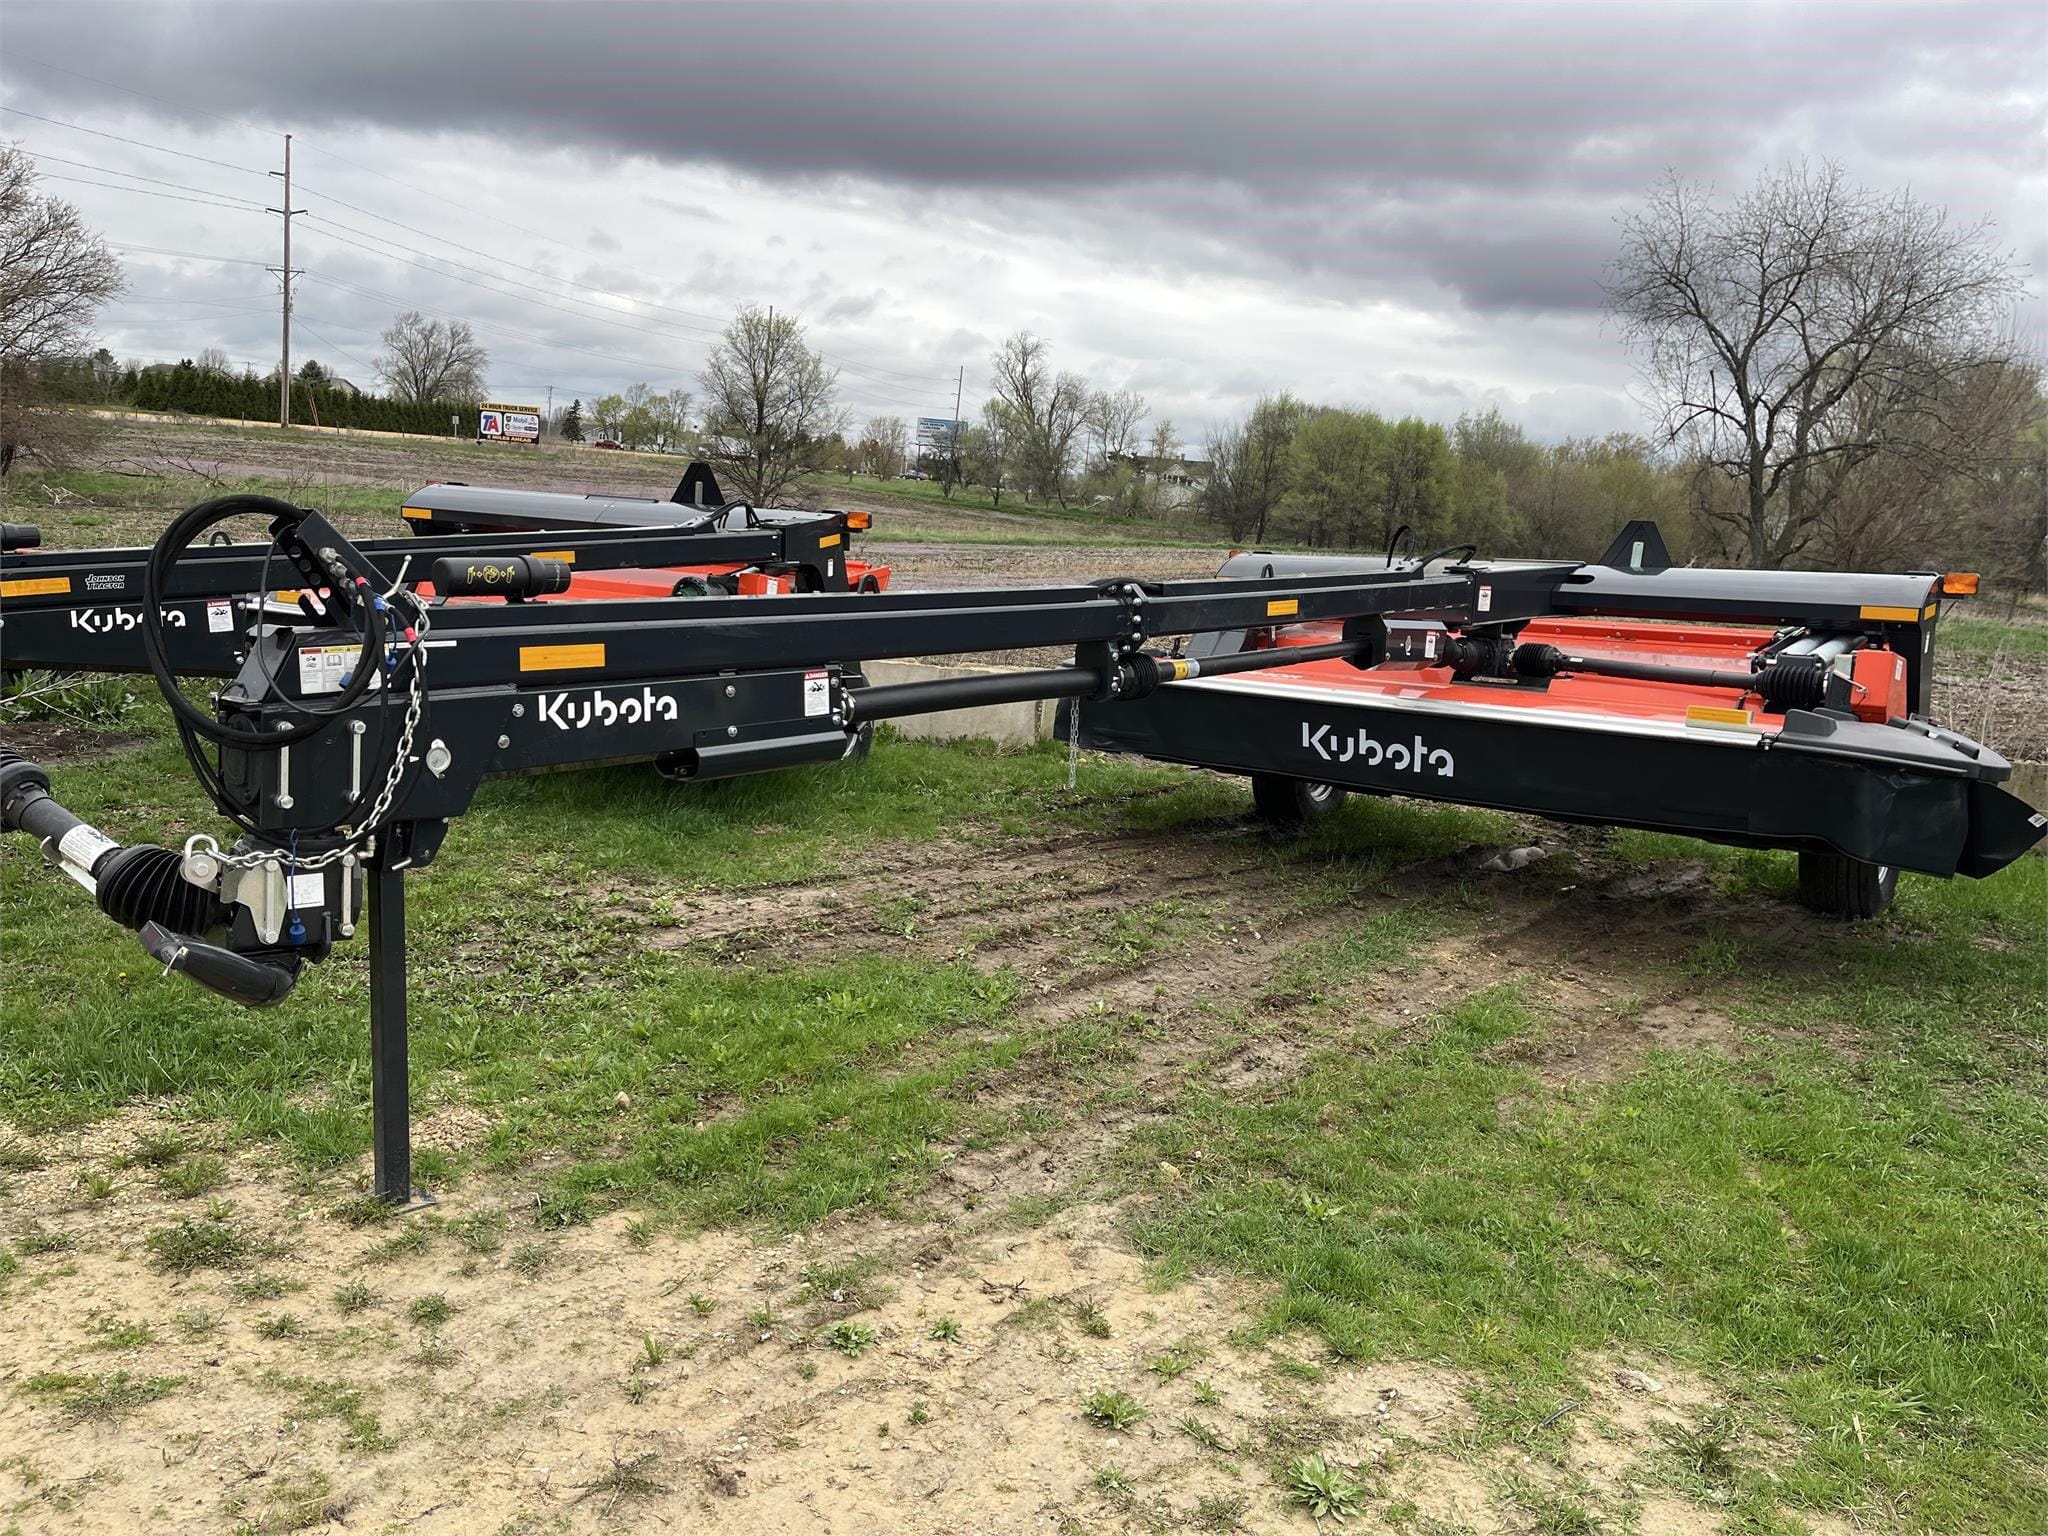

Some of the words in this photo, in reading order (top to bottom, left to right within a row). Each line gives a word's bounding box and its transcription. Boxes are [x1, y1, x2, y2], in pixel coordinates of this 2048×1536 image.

[483, 415, 499, 433] TA
[513, 416, 528, 424] Mobil
[85, 573, 125, 582] JOHNSON
[87, 582, 125, 590] TRACTOR
[538, 686, 678, 730] Kubota
[1302, 721, 1454, 778] Kubota
